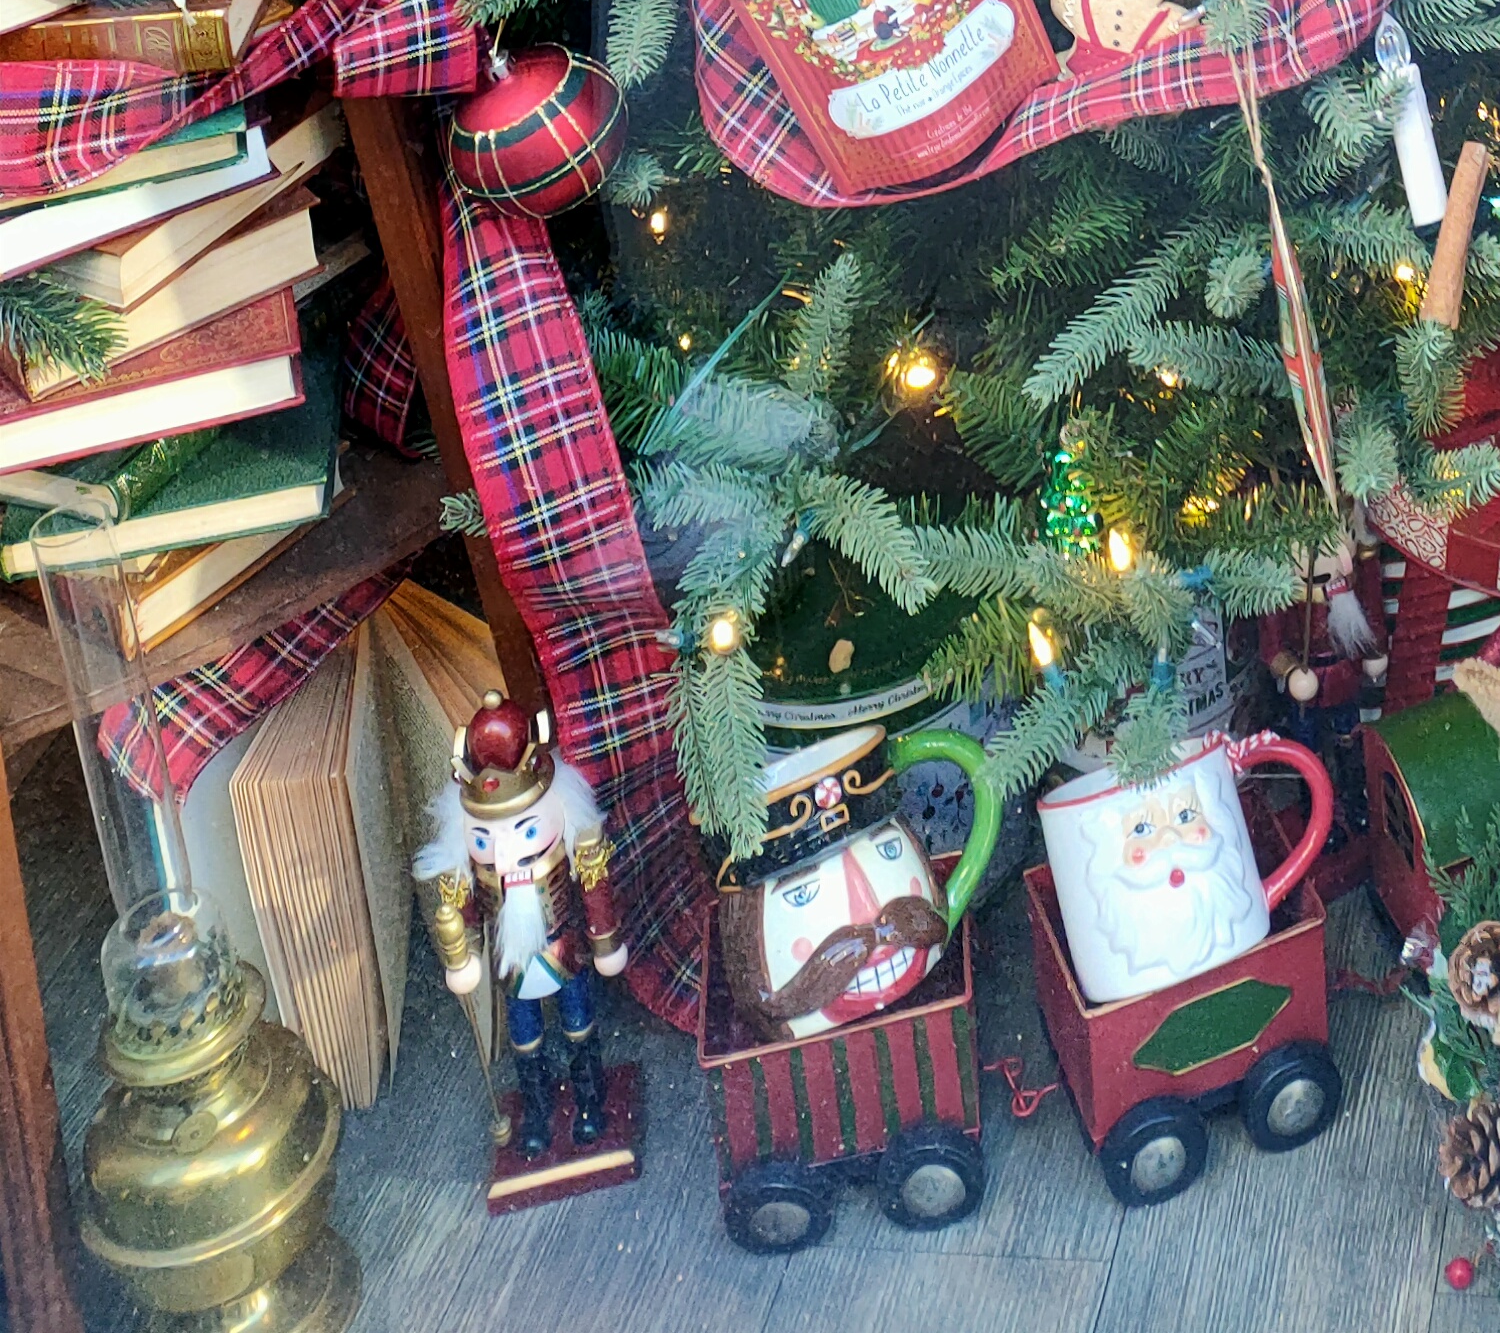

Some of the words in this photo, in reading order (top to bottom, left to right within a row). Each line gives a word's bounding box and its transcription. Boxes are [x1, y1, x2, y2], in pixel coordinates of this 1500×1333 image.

[856, 91, 881, 114] La
[878, 67, 929, 106] Petite
[928, 24, 986, 80] Nonnette
[847, 699, 885, 718] Merry
